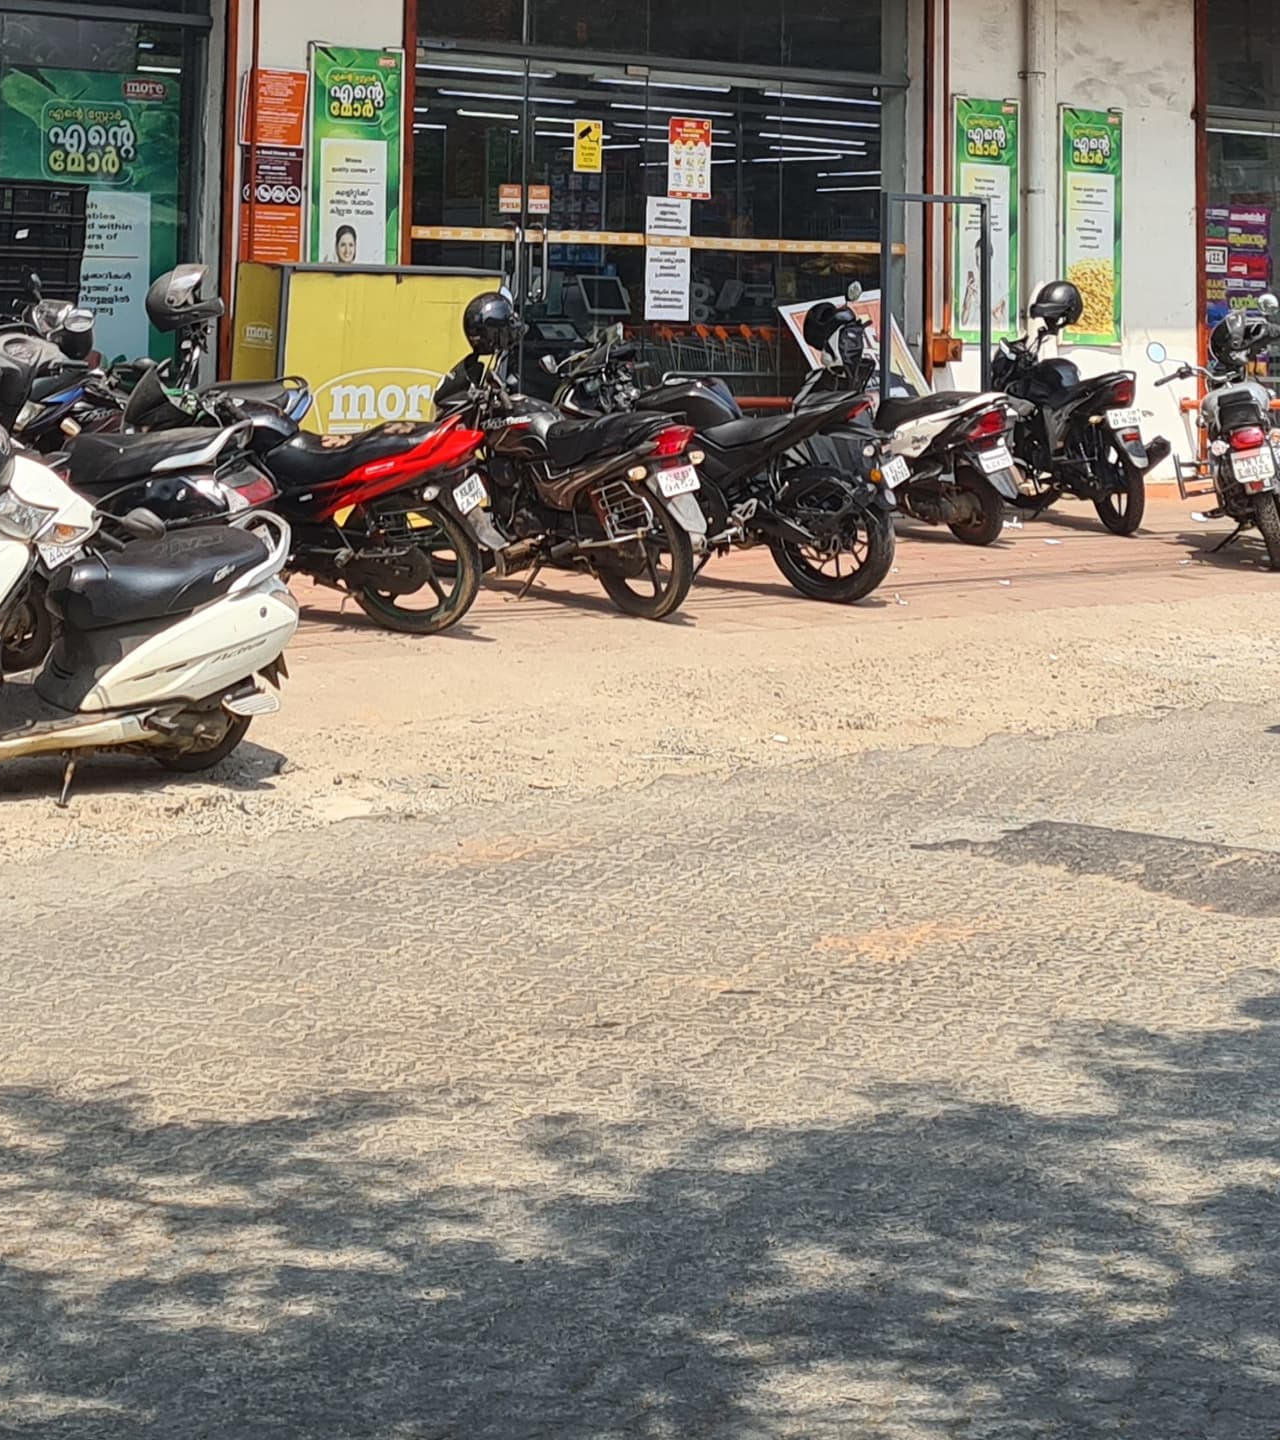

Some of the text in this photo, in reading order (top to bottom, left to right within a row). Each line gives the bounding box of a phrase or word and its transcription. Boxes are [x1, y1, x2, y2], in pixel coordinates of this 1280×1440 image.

[126, 82, 164, 94] more
[98, 223, 133, 231] within
[329, 384, 432, 420] mor
